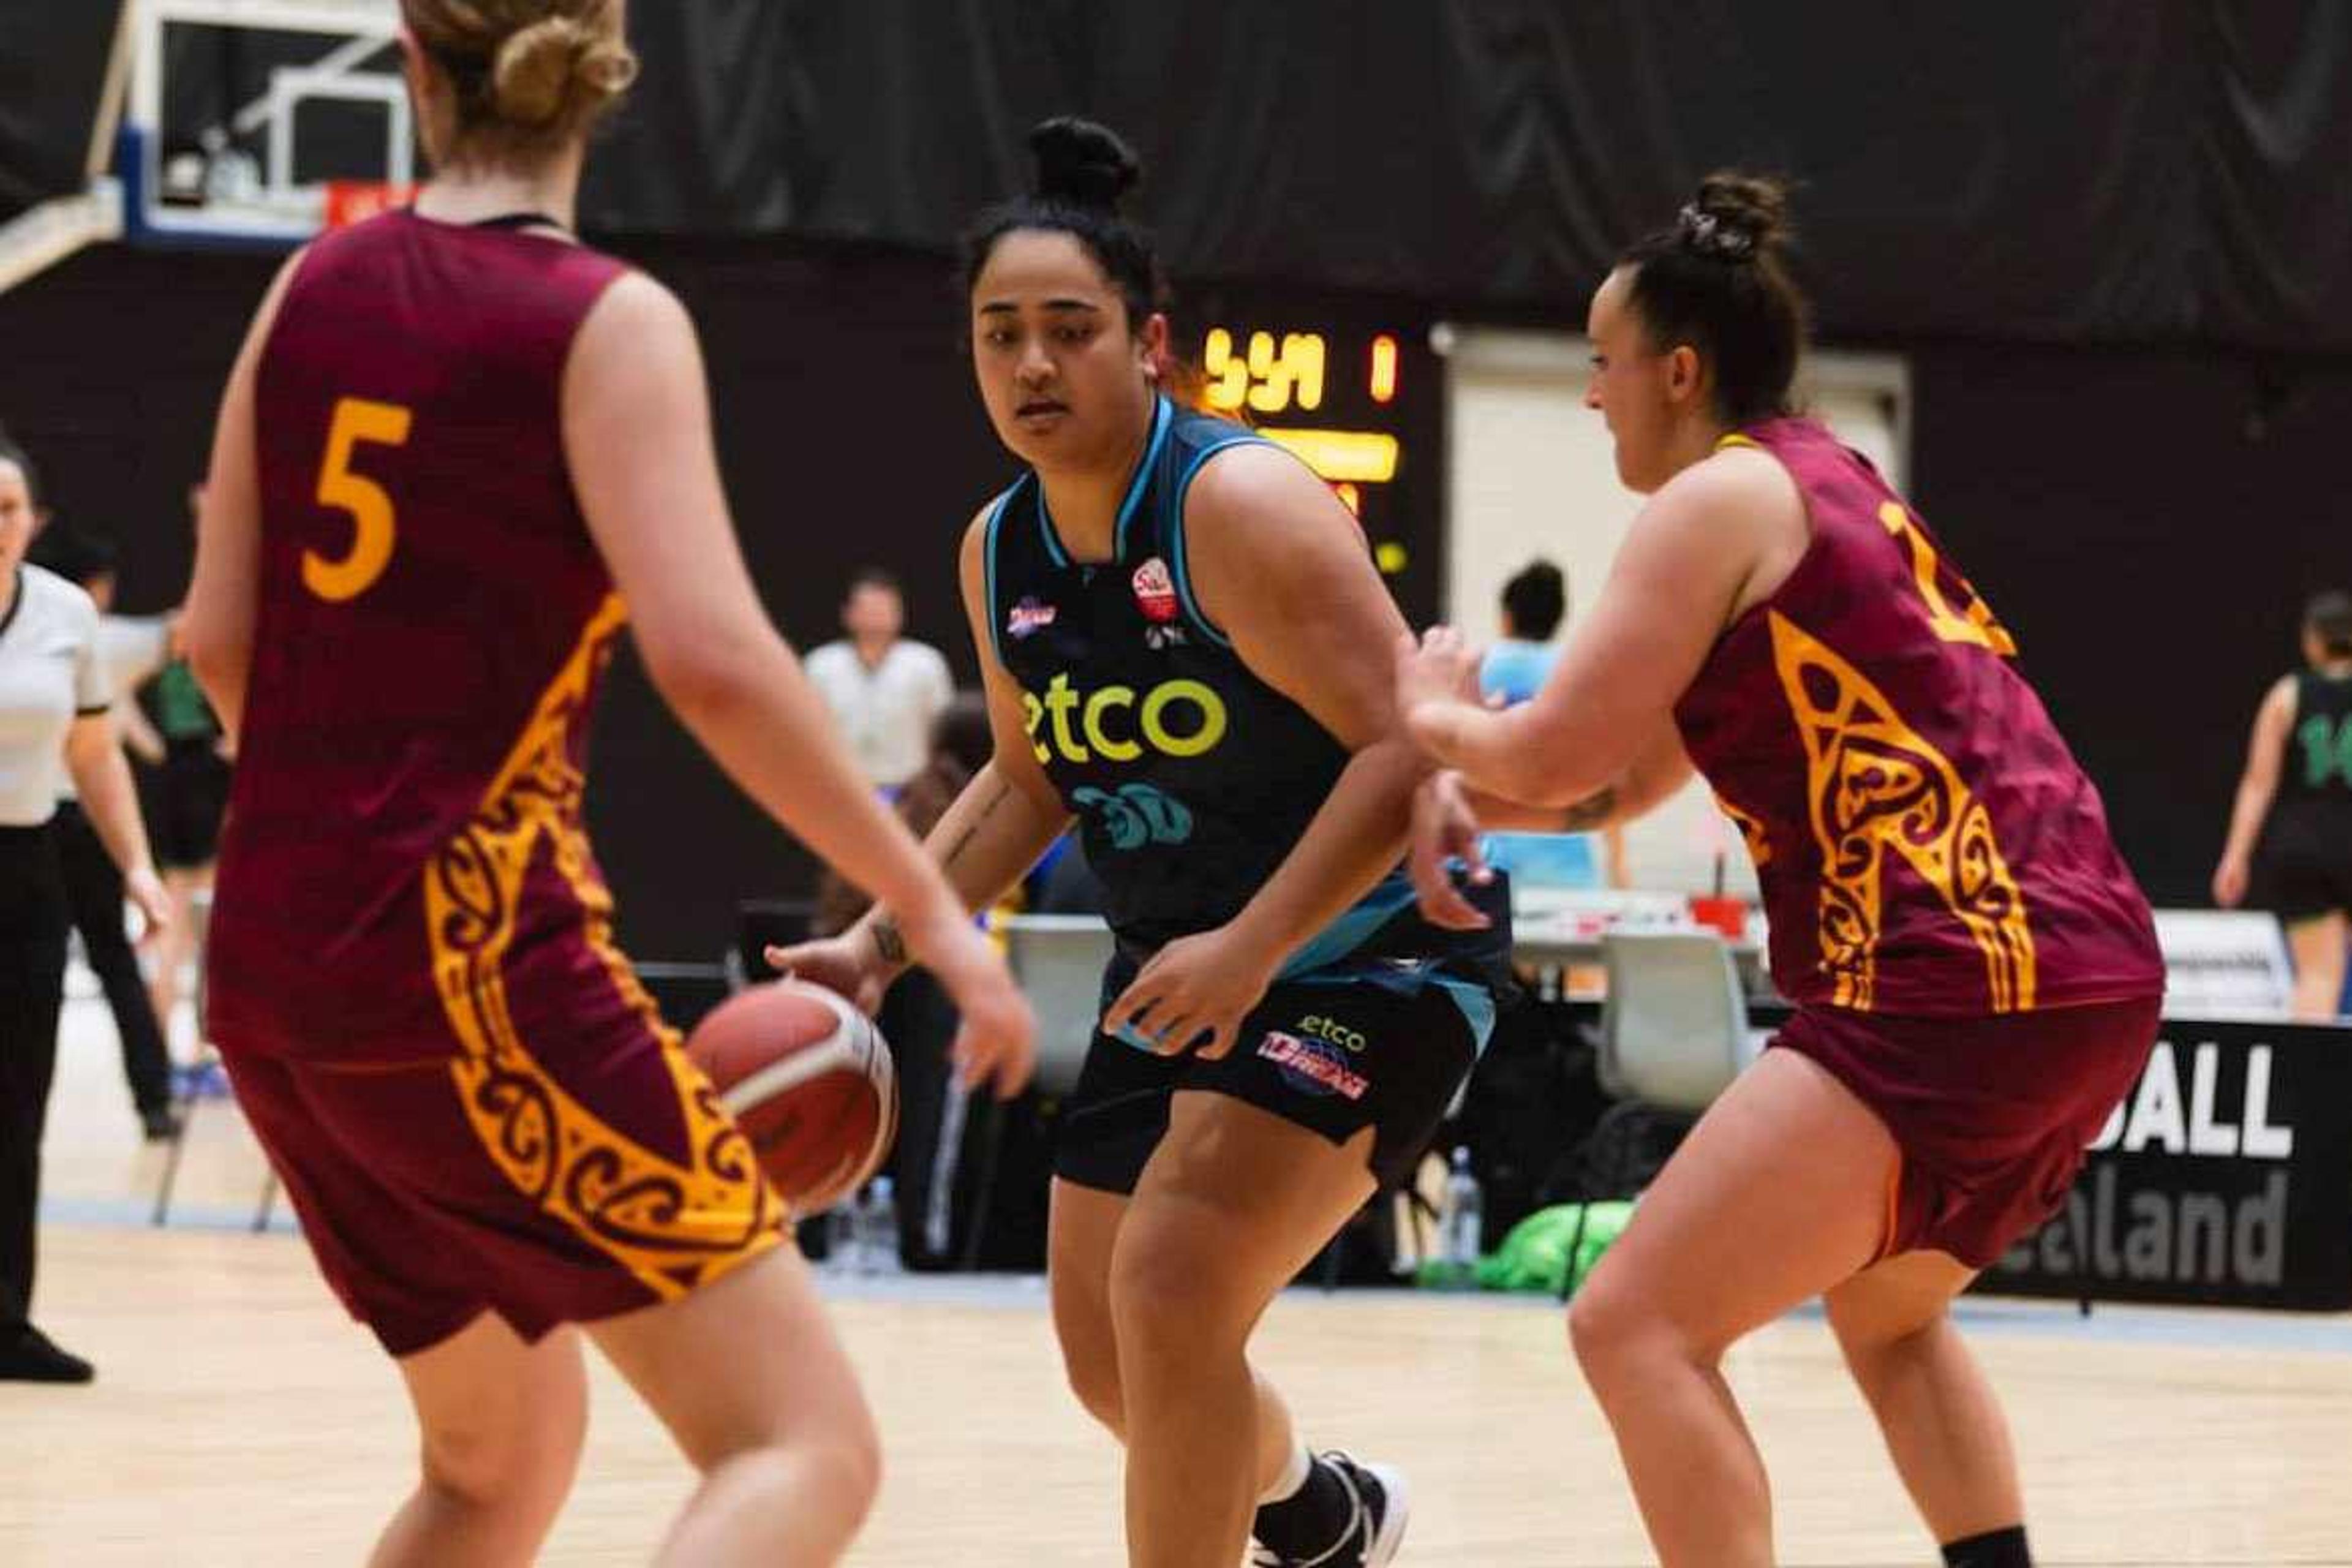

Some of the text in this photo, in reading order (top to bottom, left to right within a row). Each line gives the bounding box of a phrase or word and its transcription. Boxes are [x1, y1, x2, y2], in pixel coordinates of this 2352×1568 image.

[303, 398, 412, 601] 5
[1297, 1015, 1366, 1051] etco
[2086, 1041, 2293, 1159] ALL
